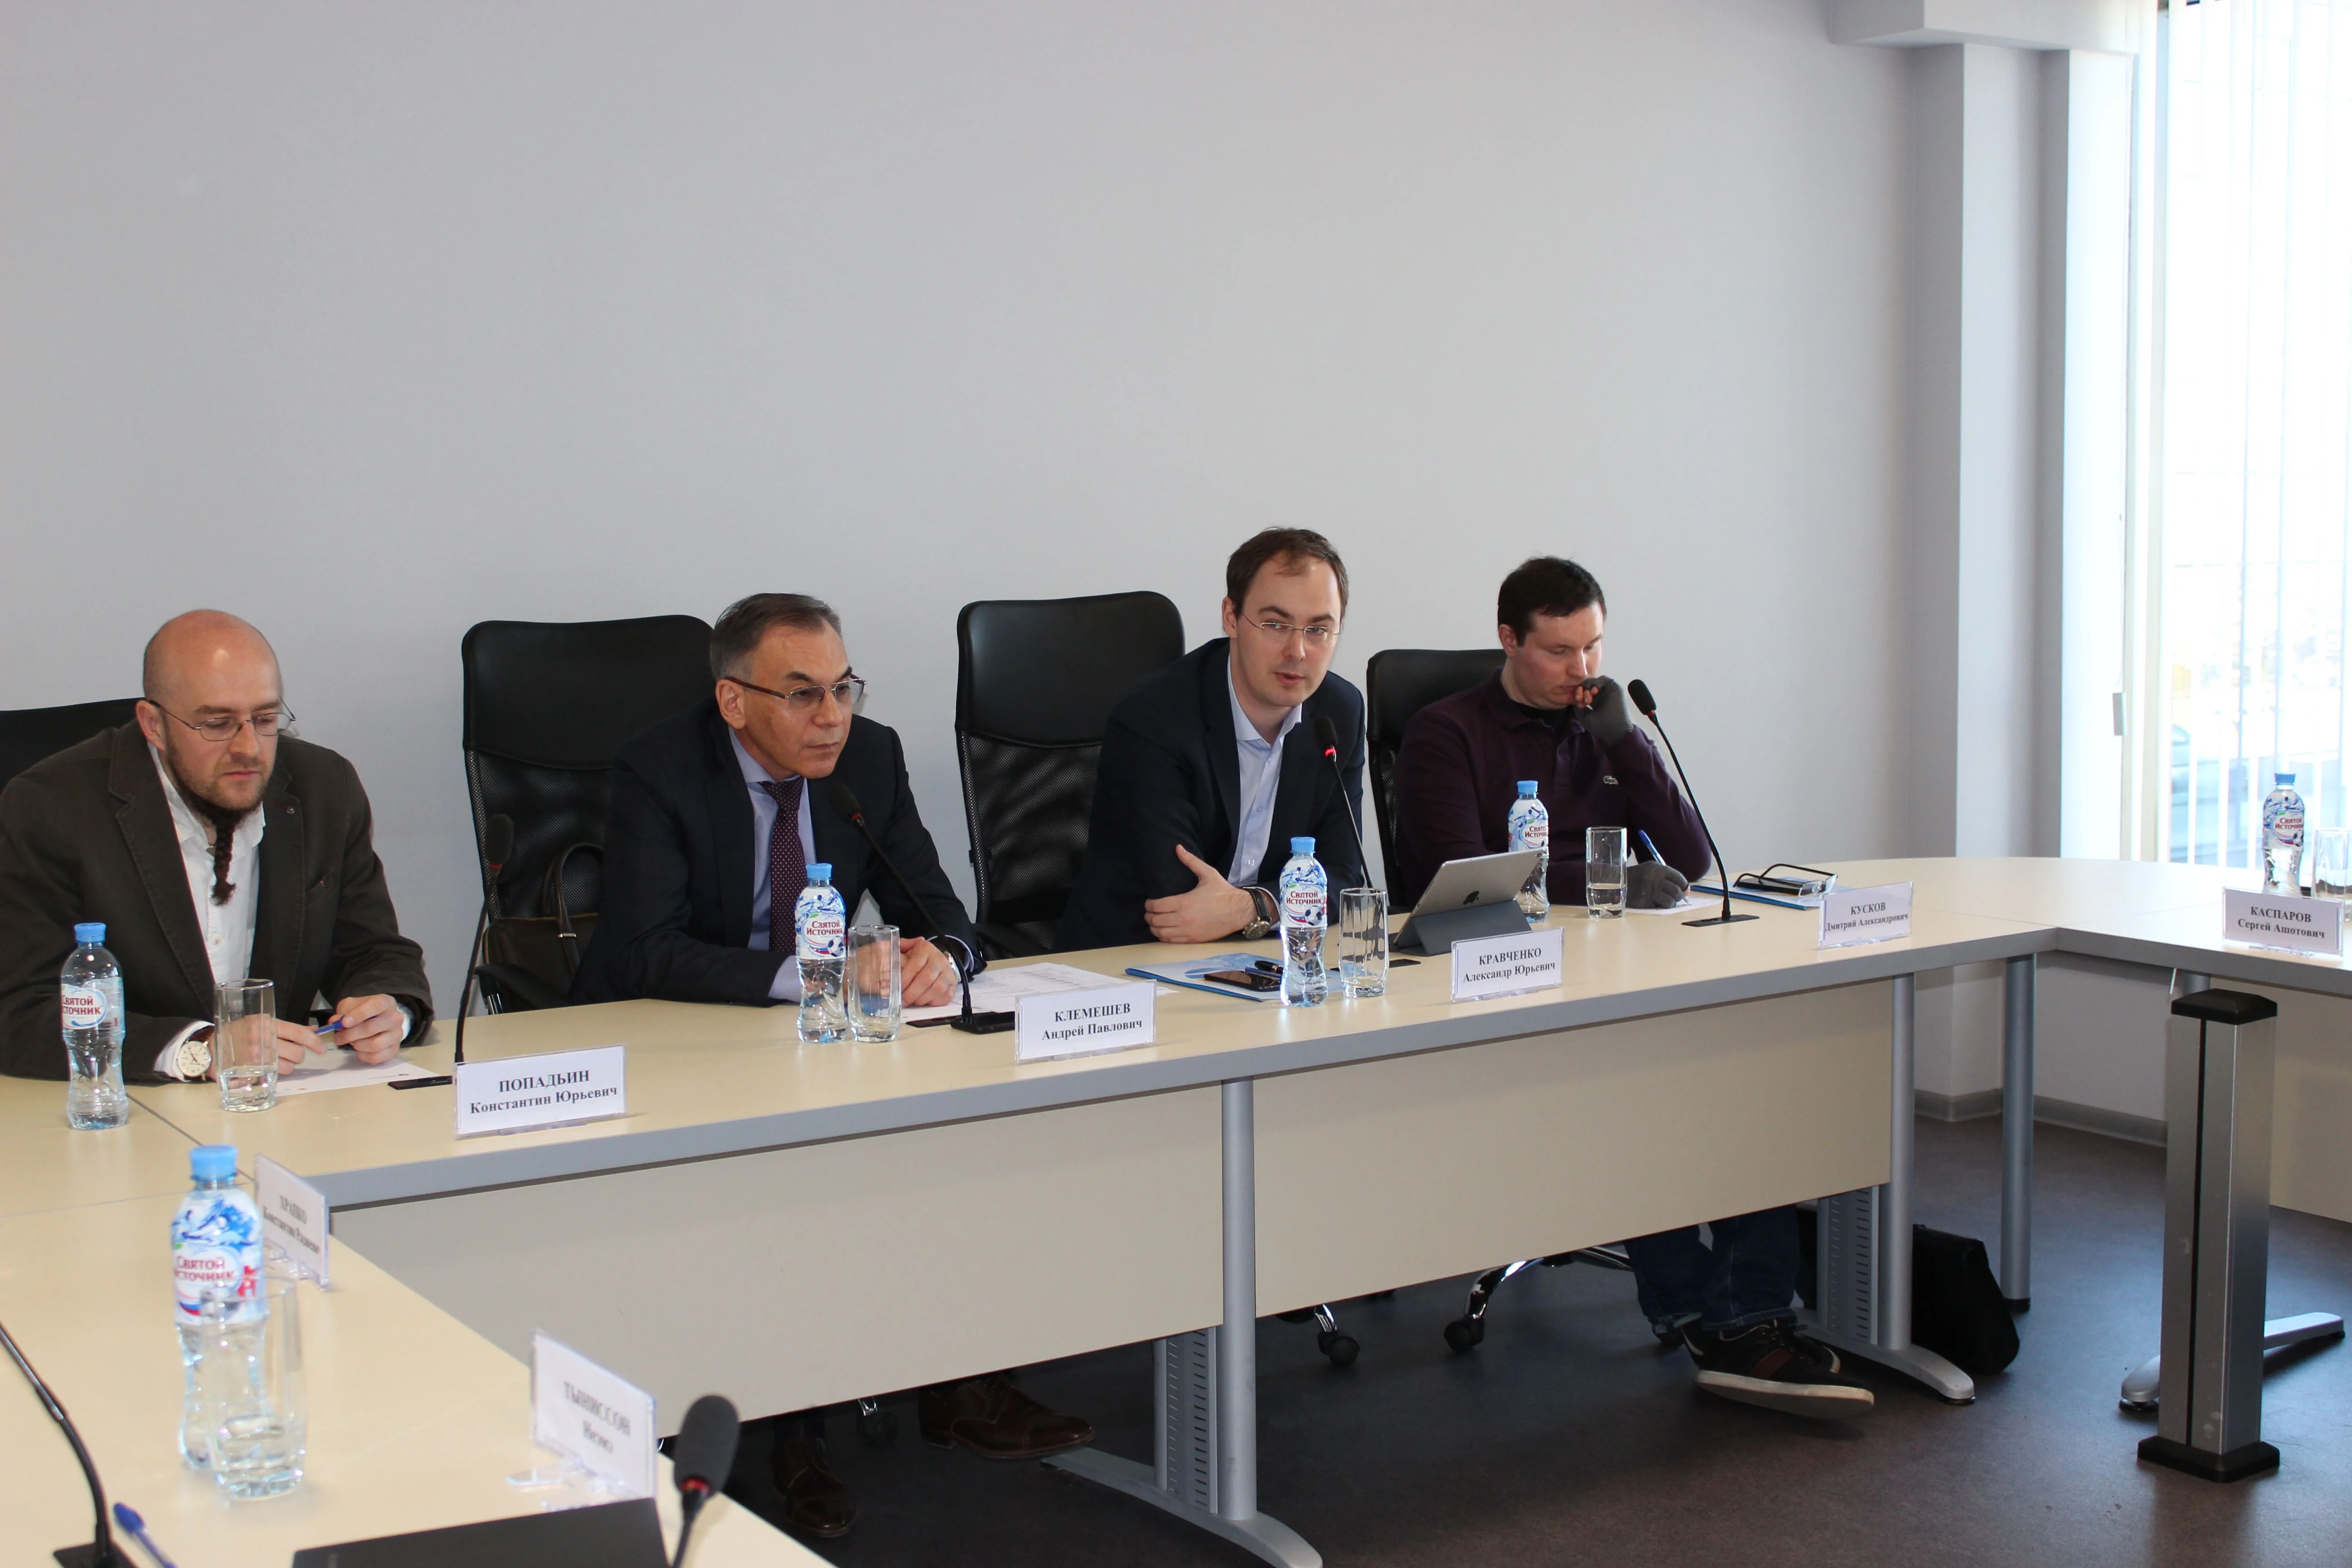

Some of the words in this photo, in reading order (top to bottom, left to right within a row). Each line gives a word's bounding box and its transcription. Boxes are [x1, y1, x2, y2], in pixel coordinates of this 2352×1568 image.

[1851, 902, 1886, 915] КУСКОВ
[2250, 906, 2311, 923] КАСПАРОВ
[1825, 920, 1856, 931] Дмитрий
[1858, 913, 1908, 927] Александрович
[2238, 918, 2270, 931] Сергей
[2273, 924, 2325, 938] Ашотович
[1479, 947, 1541, 965] КРАВЧЕНКО
[1463, 968, 1512, 983] Александр
[1514, 962, 1555, 976] Юрьевич
[63, 1006, 102, 1015] точник
[1055, 1003, 1131, 1022] КЛЕМЕШЕВ
[1042, 1026, 1084, 1040] Андрей
[1088, 1020, 1142, 1034] Павлович
[499, 1070, 590, 1092] ПОПАДЬИН
[470, 1096, 551, 1114] Константин
[556, 1087, 617, 1104] Юрьевич
